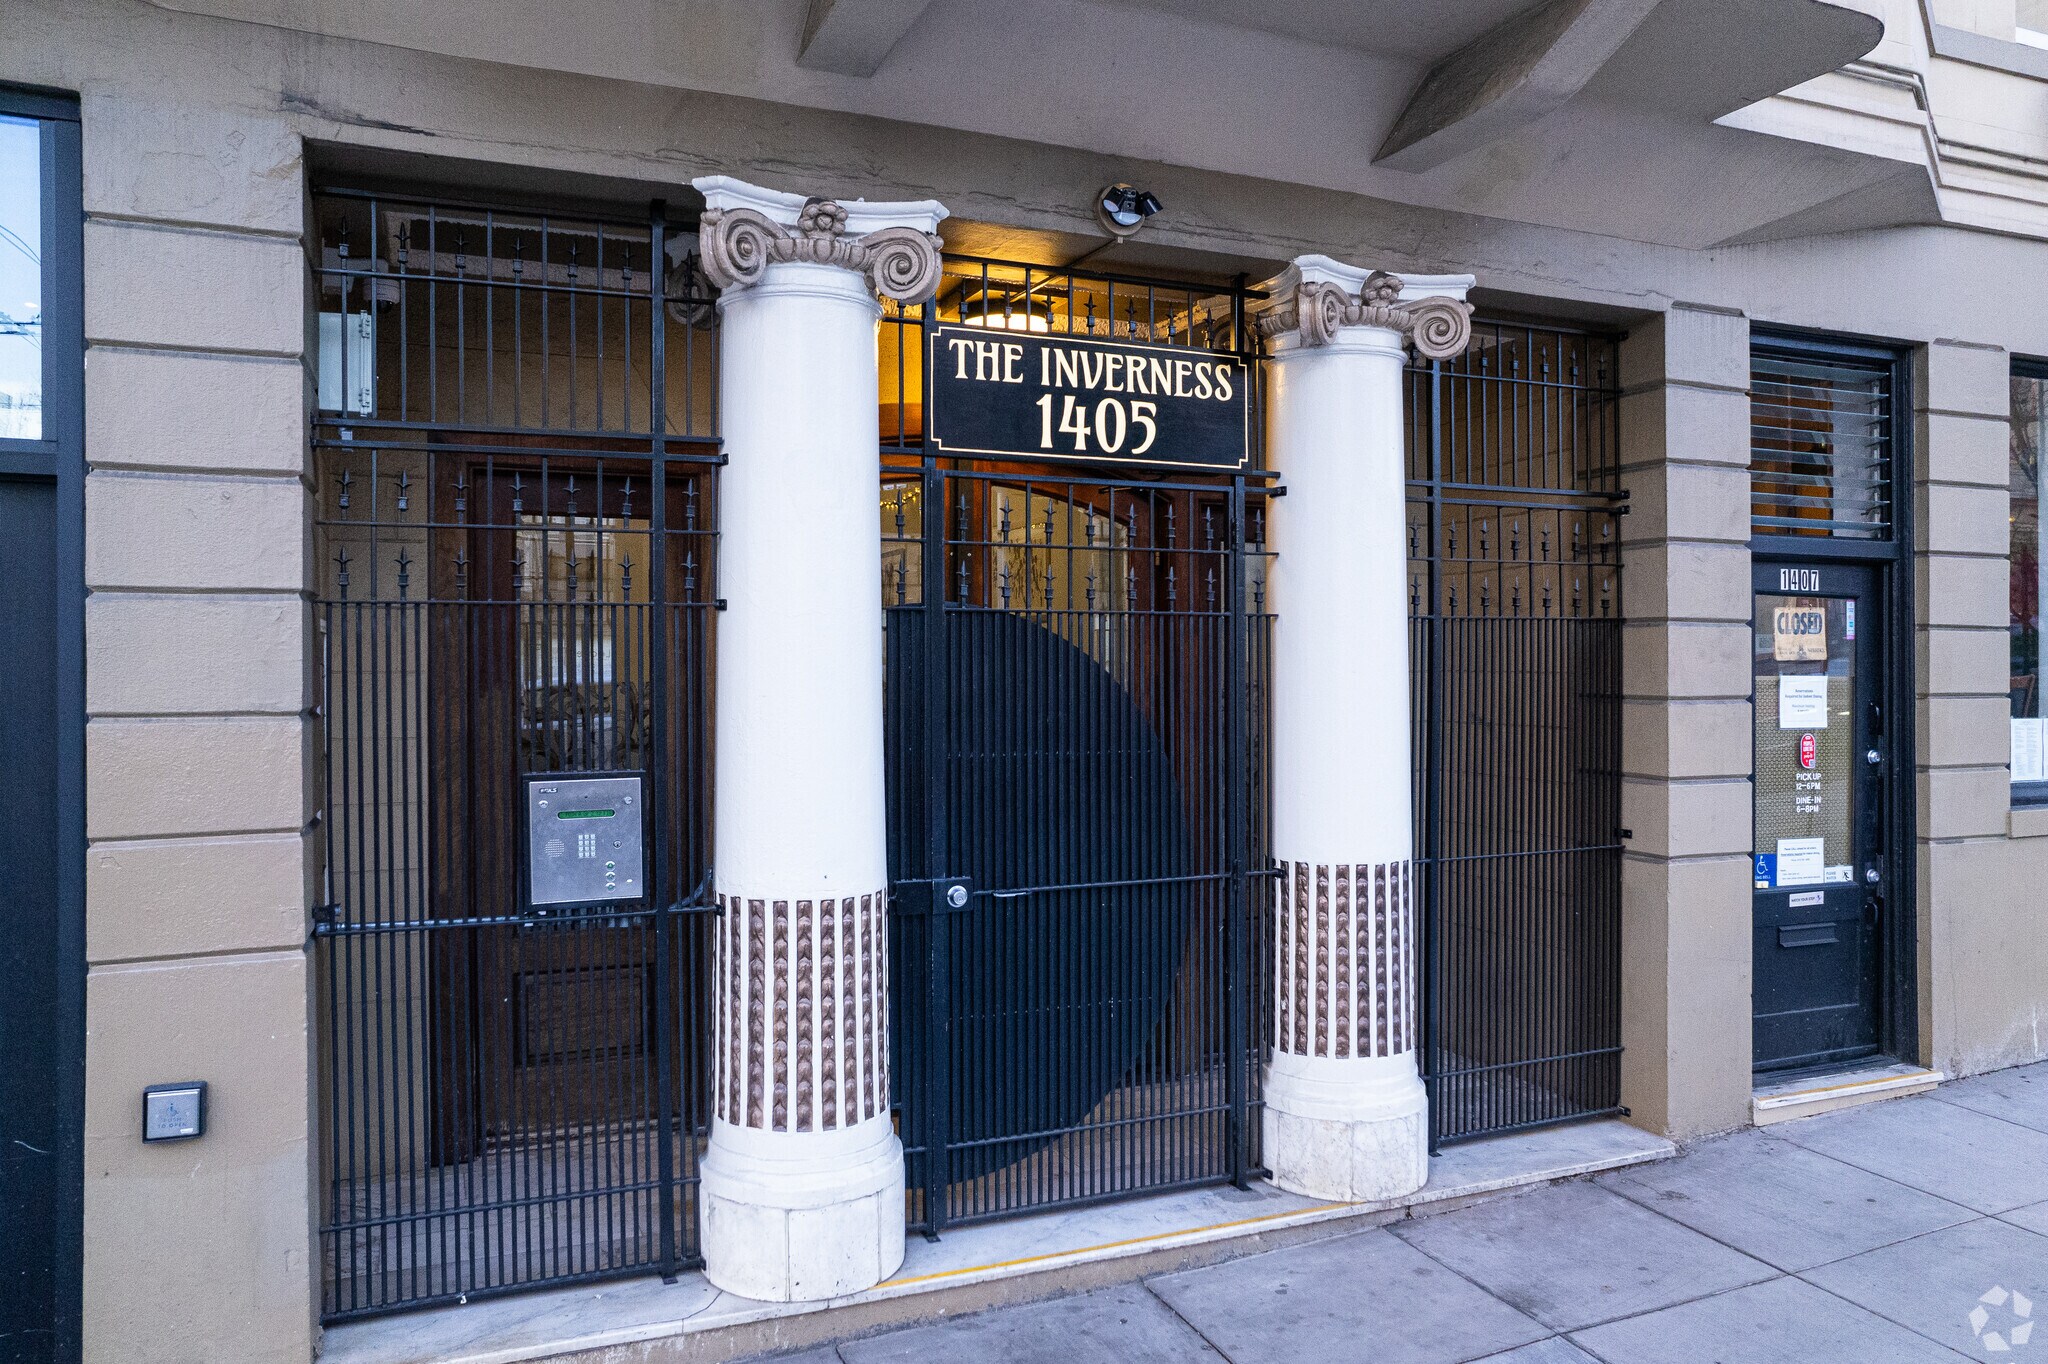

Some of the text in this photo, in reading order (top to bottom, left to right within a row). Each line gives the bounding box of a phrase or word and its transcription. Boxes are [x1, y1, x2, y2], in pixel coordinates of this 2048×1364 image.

[949, 339, 1233, 402] THE INVERNESS
[1036, 393, 1157, 455] 1405
[1782, 569, 1818, 591] 1407
[1777, 612, 1823, 635] CLOSED
